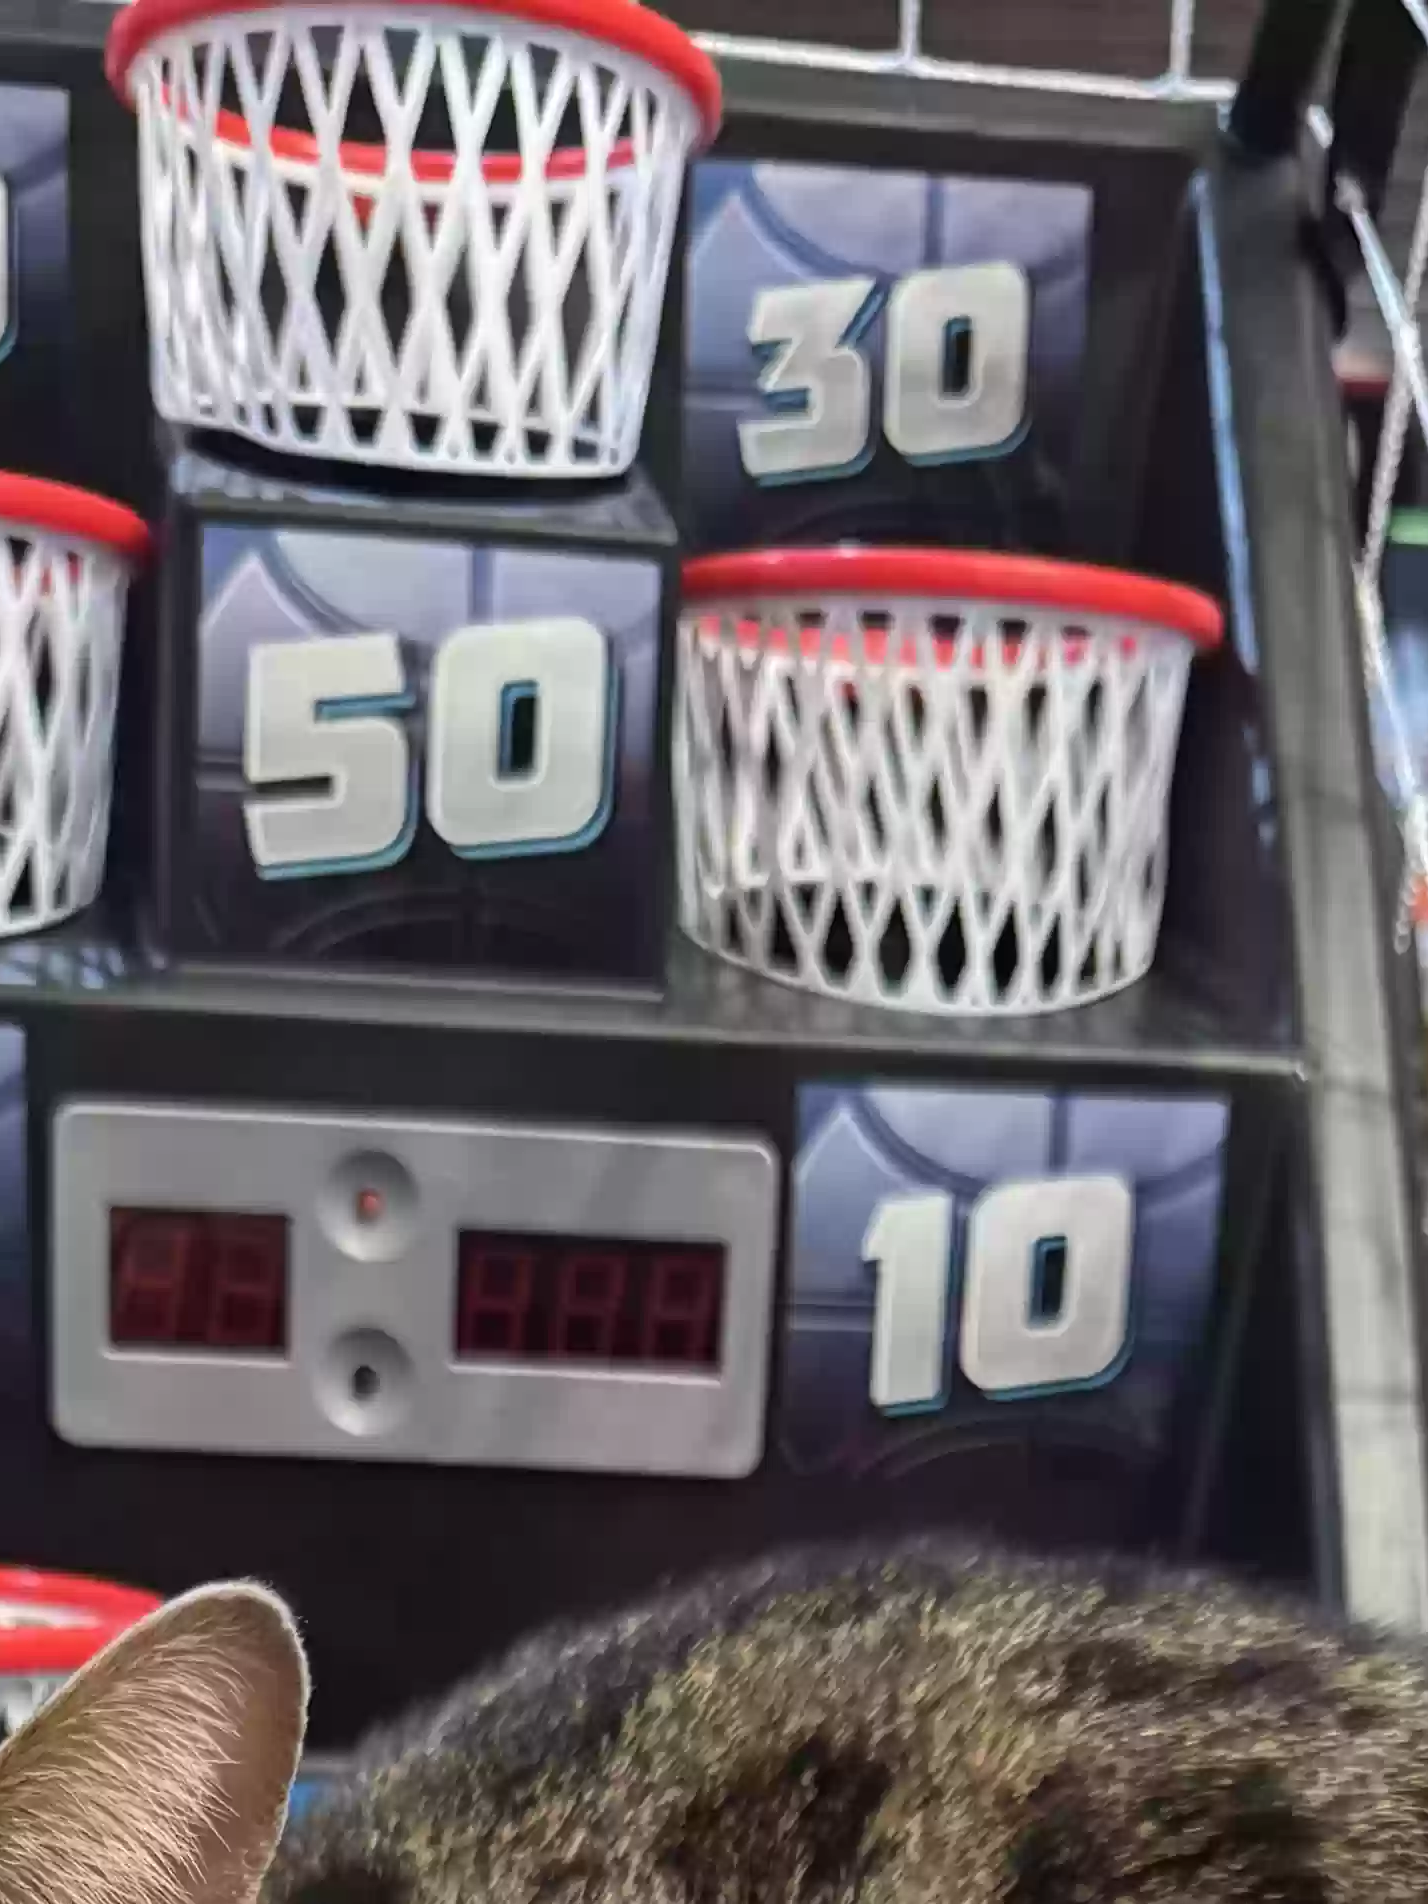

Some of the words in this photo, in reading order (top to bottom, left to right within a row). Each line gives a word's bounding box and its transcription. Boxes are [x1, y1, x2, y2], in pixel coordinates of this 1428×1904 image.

[736, 259, 1032, 487] 30
[243, 616, 617, 880] 50
[861, 1173, 1135, 1419] 10
